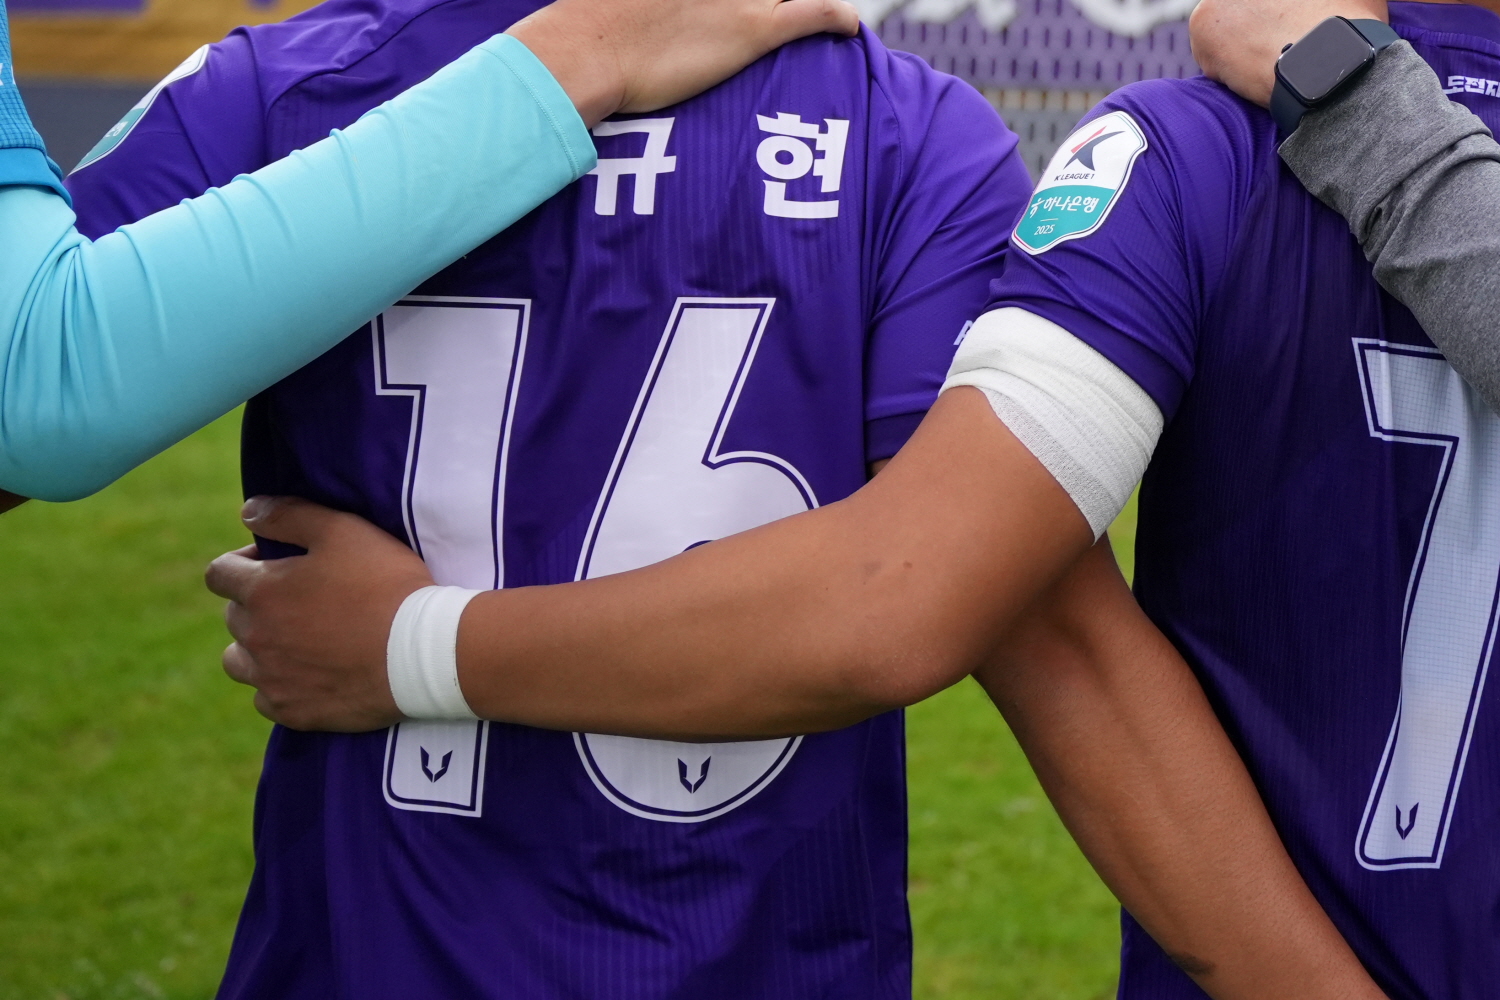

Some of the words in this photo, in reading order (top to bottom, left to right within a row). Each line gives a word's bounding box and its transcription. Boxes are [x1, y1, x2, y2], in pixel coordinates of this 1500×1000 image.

[1043, 195, 1100, 213] 하나은행
[1034, 224, 1055, 236] 2025
[371, 295, 820, 824] 16
